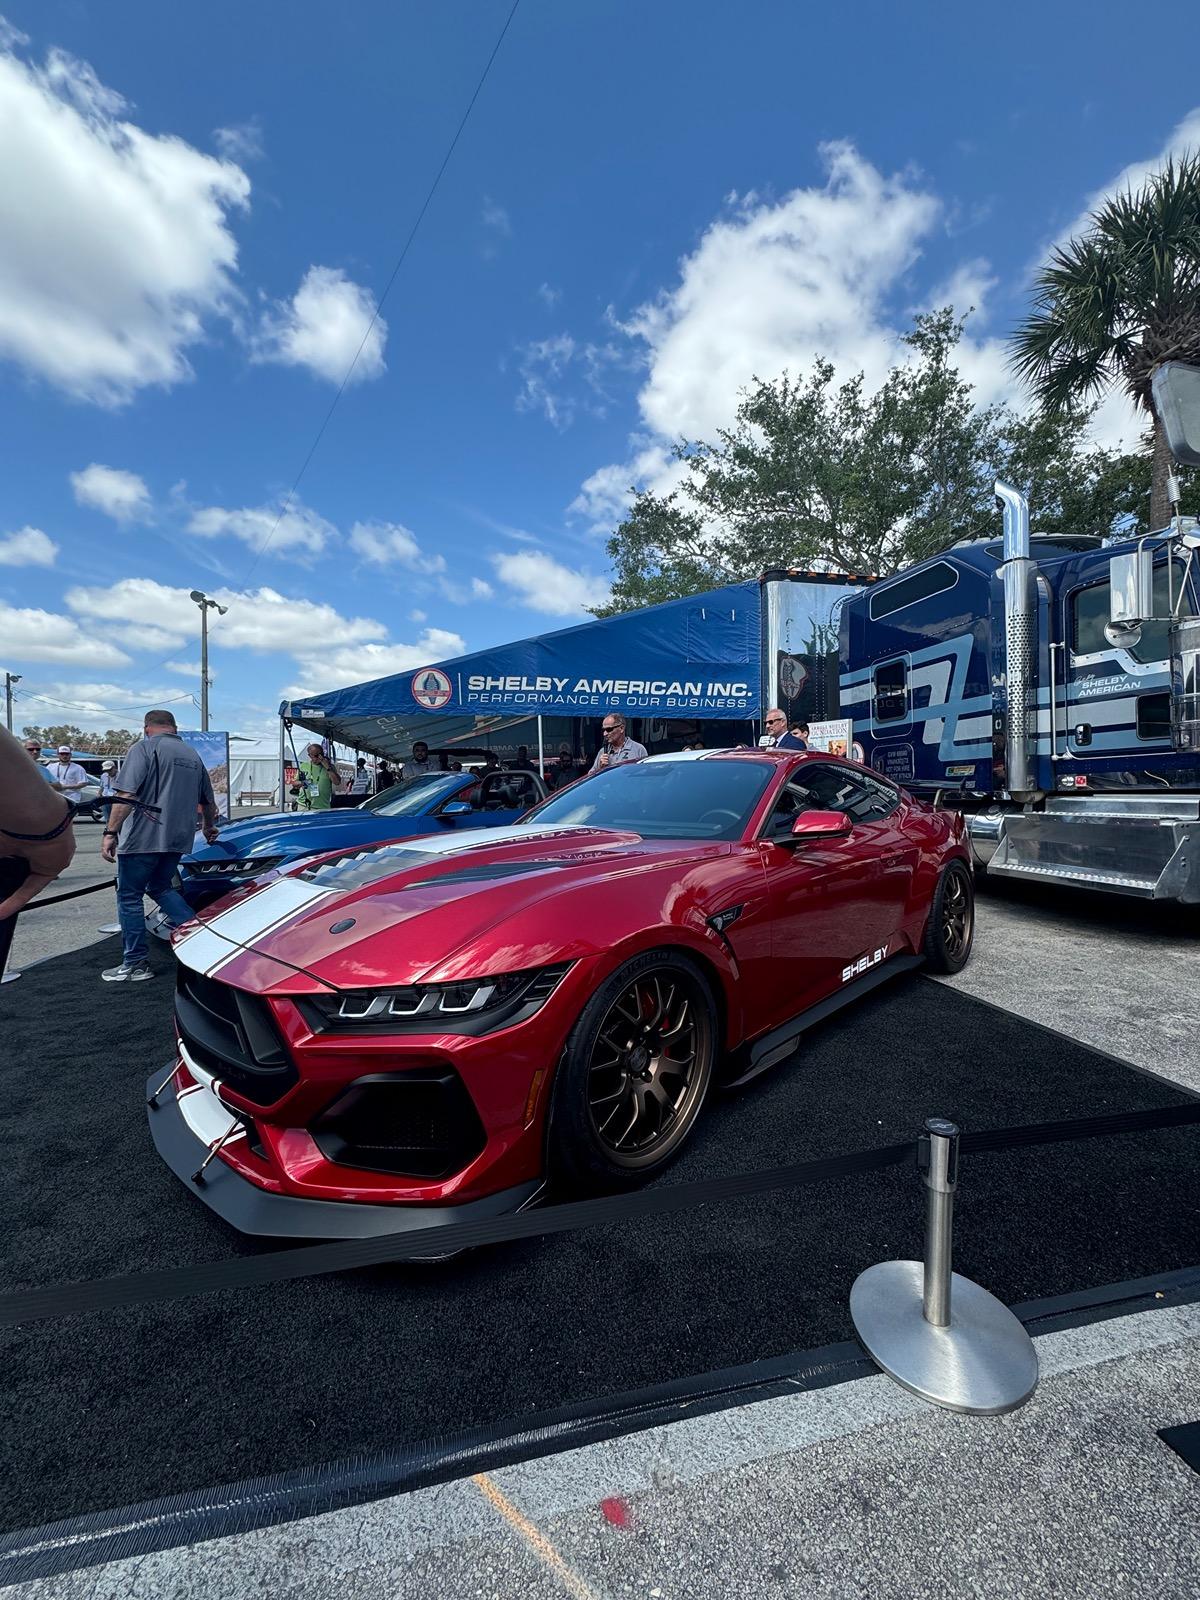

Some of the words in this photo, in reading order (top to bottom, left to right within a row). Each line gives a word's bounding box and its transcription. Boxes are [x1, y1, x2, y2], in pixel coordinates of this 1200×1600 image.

[468, 675, 570, 692] SHELBY
[573, 679, 702, 695] AMERICAN
[706, 682, 753, 697] INC.
[1078, 681, 1141, 697] AMERICAN
[1082, 675, 1129, 689] SHELBY
[468, 693, 600, 705] PERFORMANCE
[605, 696, 620, 705] IS
[626, 697, 660, 706] OUR
[666, 698, 747, 708] BUSINESS
[842, 944, 889, 982] SHELBY
